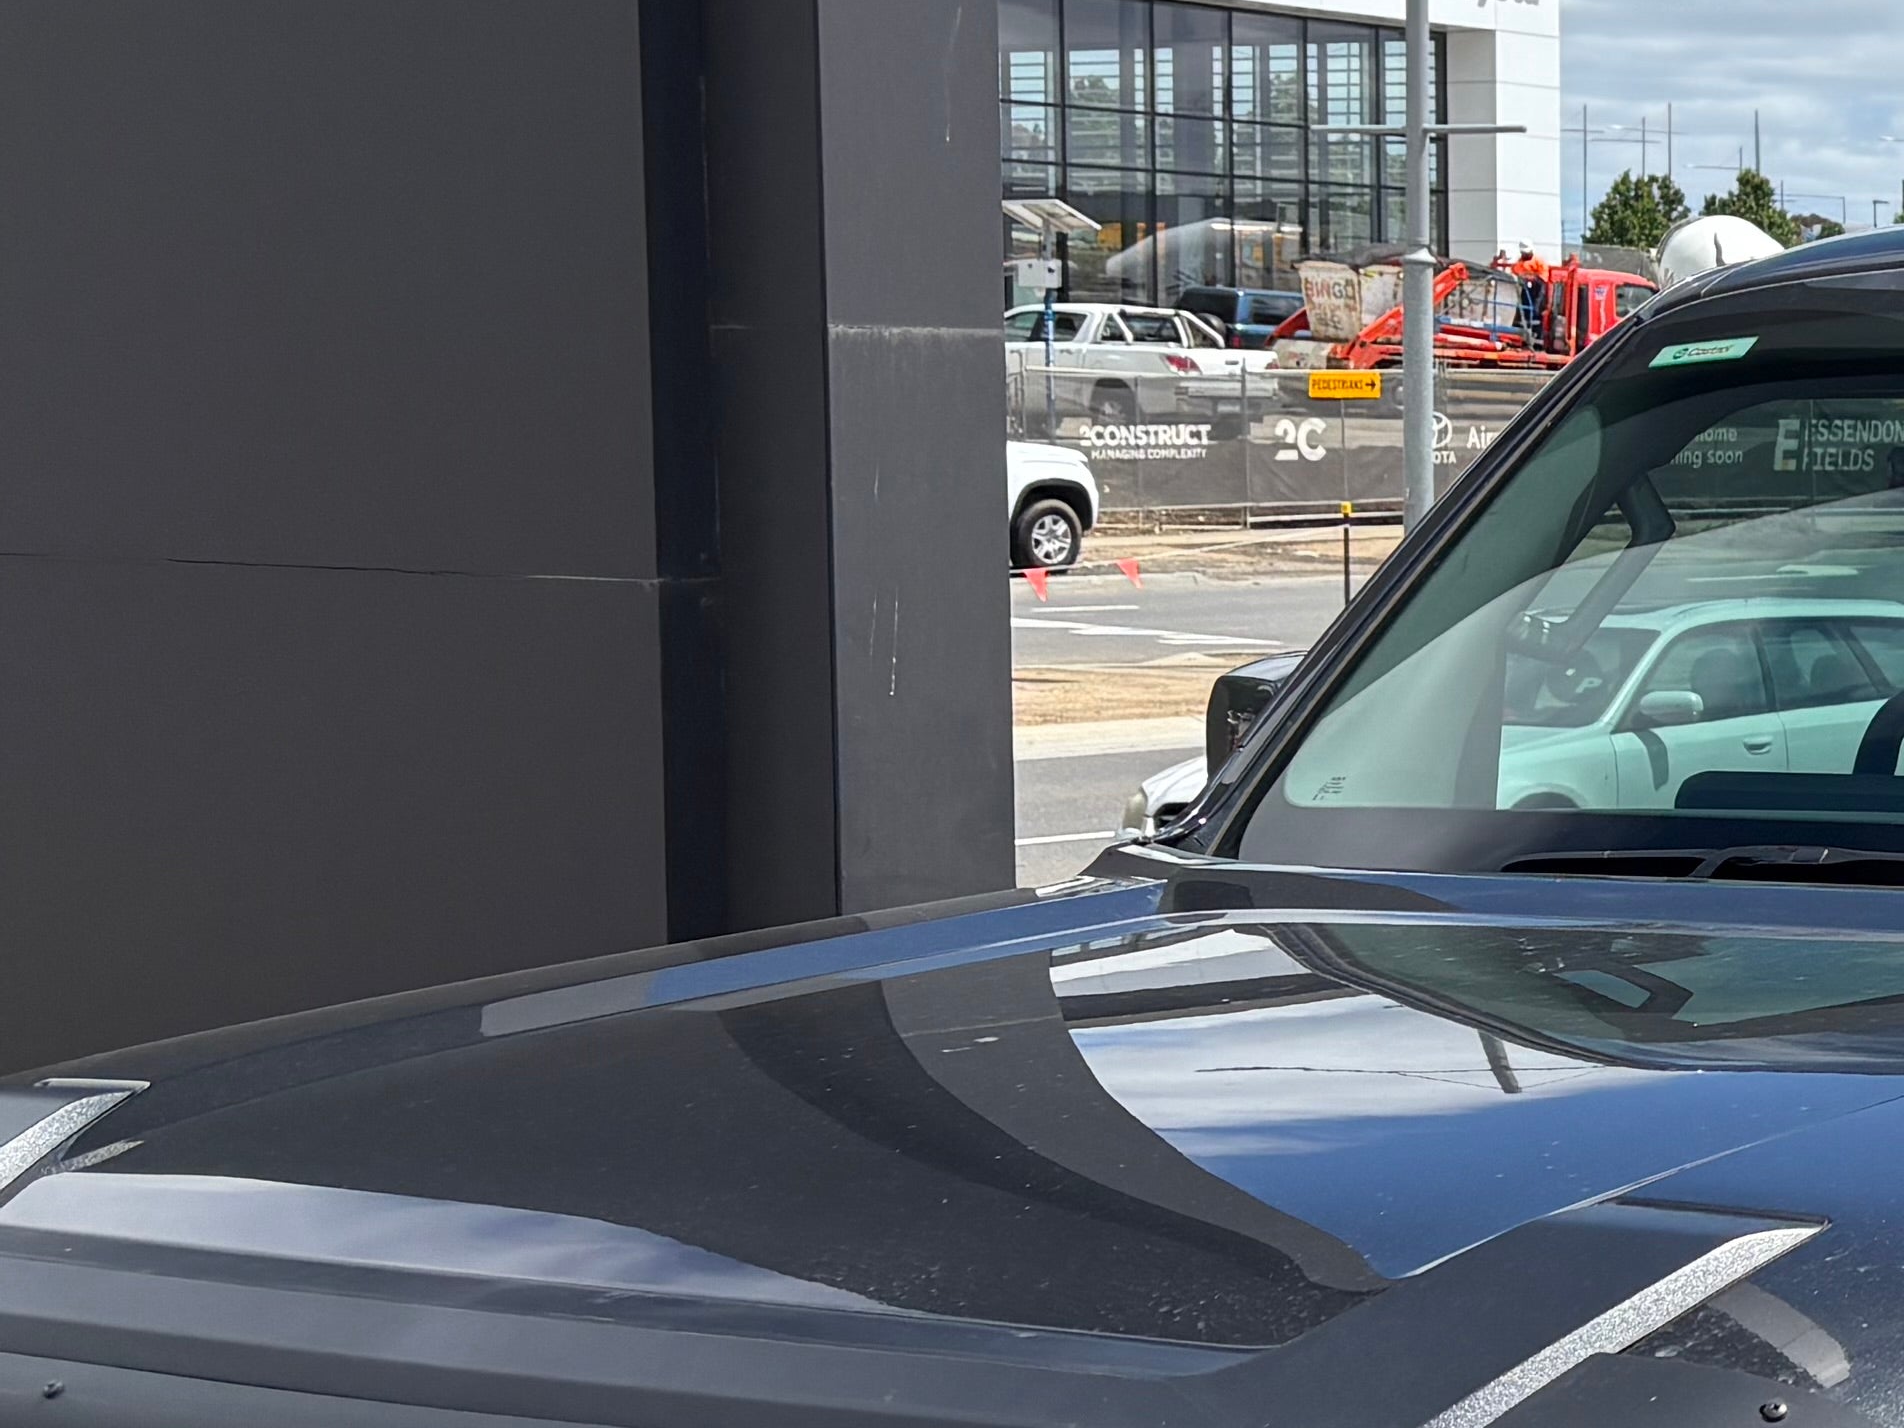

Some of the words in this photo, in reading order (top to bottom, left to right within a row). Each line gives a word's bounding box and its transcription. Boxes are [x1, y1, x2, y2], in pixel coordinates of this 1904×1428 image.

[1091, 447, 1146, 460] MANAGING
[1149, 447, 1207, 460] COMPLEXITY
[1706, 450, 1744, 465] soon
[1802, 447, 1875, 472] FIELDS
